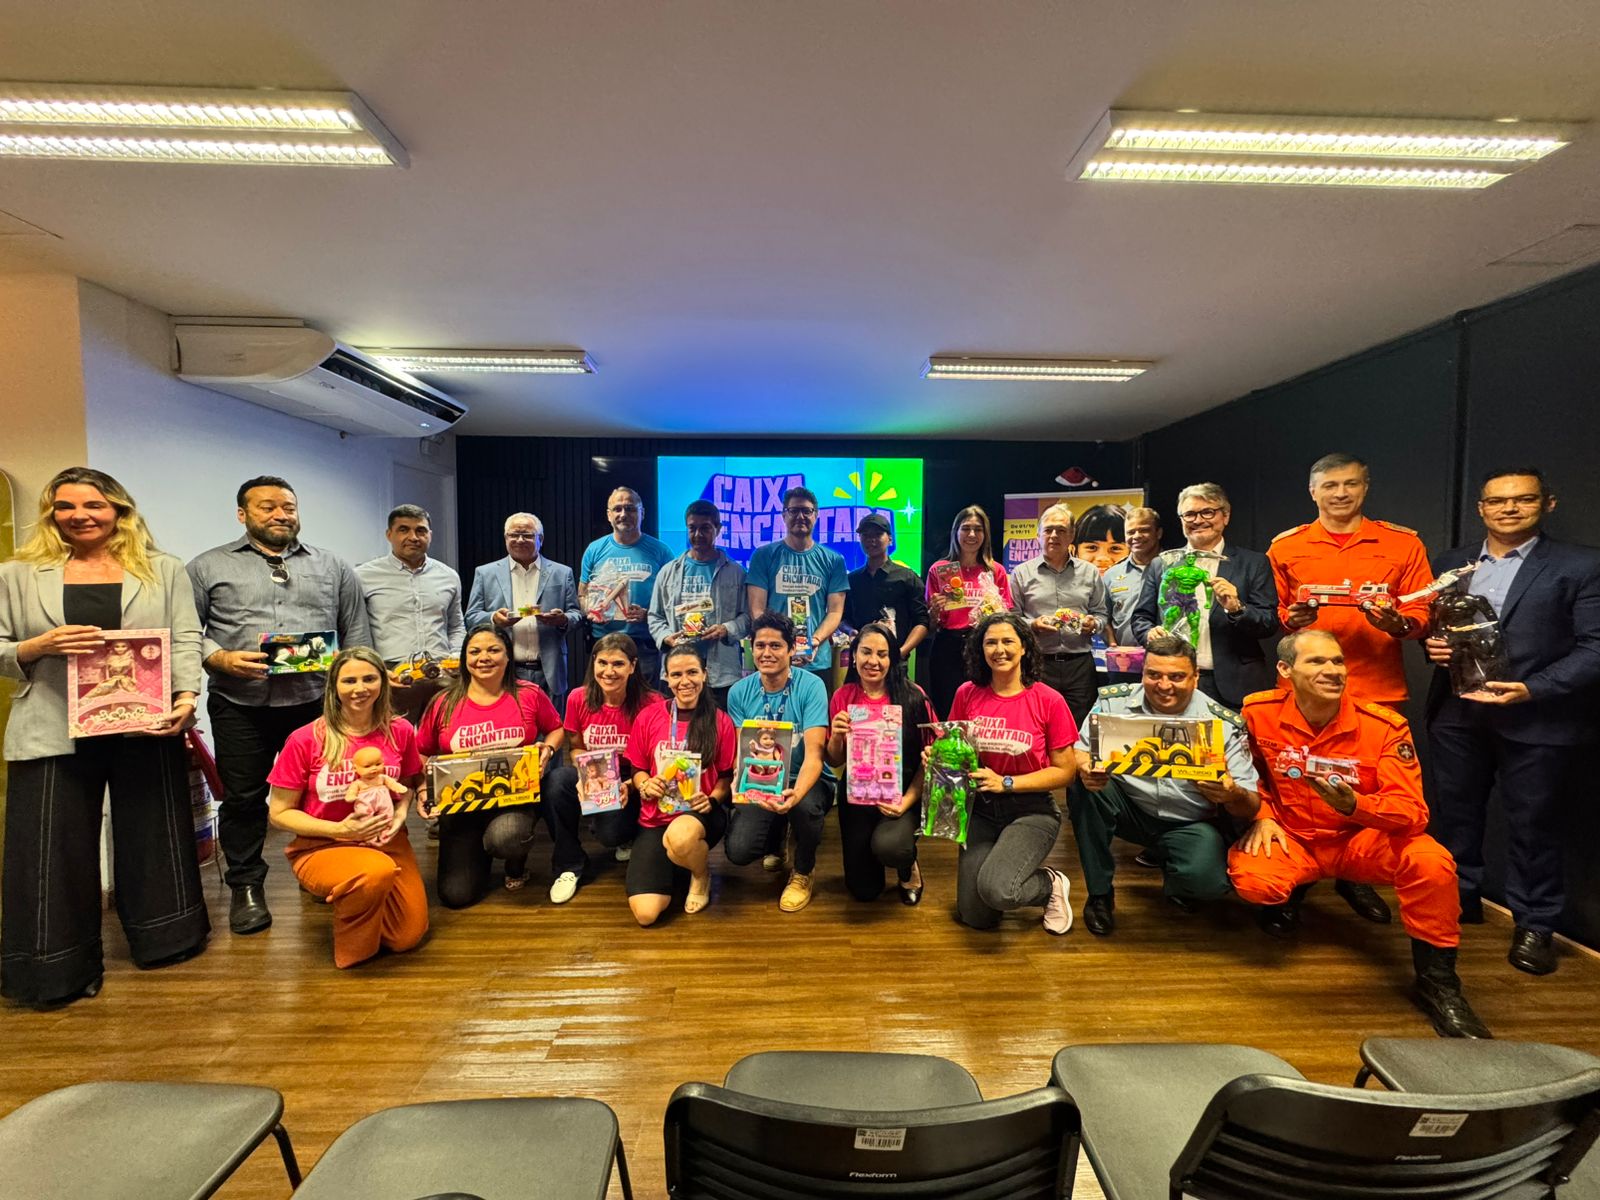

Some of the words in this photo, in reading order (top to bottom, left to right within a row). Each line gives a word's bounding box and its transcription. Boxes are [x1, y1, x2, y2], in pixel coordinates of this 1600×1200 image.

[715, 507, 893, 549] ENCATAD
[1009, 539, 1040, 550] CAIXA
[1009, 550, 1040, 561] ENCAN
[460, 722, 493, 737] CAIXA
[590, 725, 616, 735] CAIXA
[459, 728, 524, 749] ENCANTADA
[589, 734, 628, 745] ENCANTA
